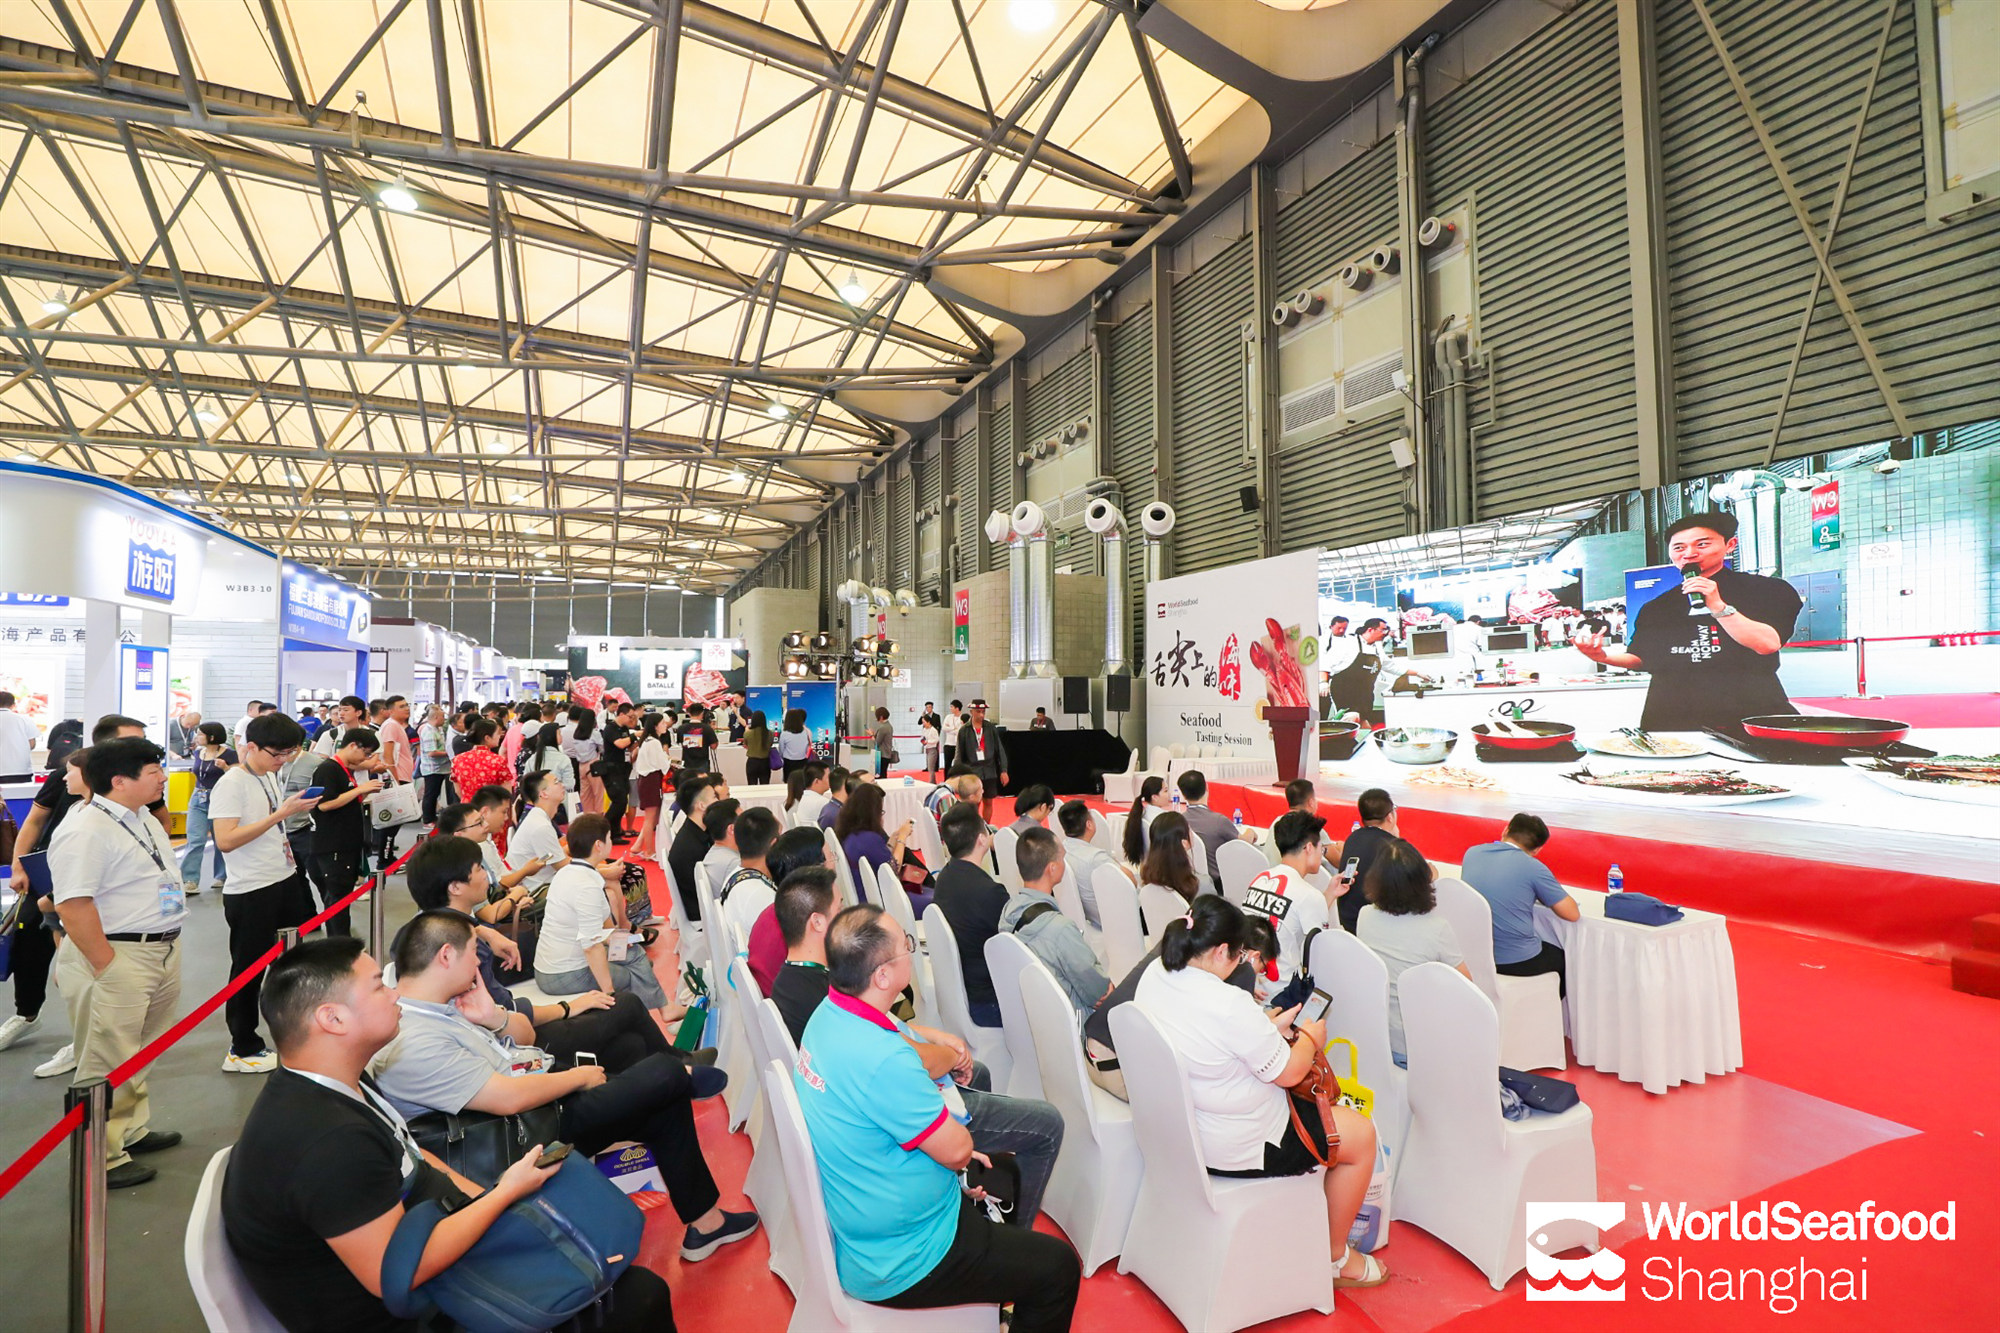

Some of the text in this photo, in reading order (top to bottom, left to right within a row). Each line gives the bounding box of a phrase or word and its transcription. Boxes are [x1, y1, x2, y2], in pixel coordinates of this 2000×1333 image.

[1812, 491, 1837, 512] W3
[955, 599, 968, 617] W3
[960, 634, 965, 650] 8
[1180, 712, 1222, 728] Seafood
[1195, 731, 1252, 747] Tasting Session
